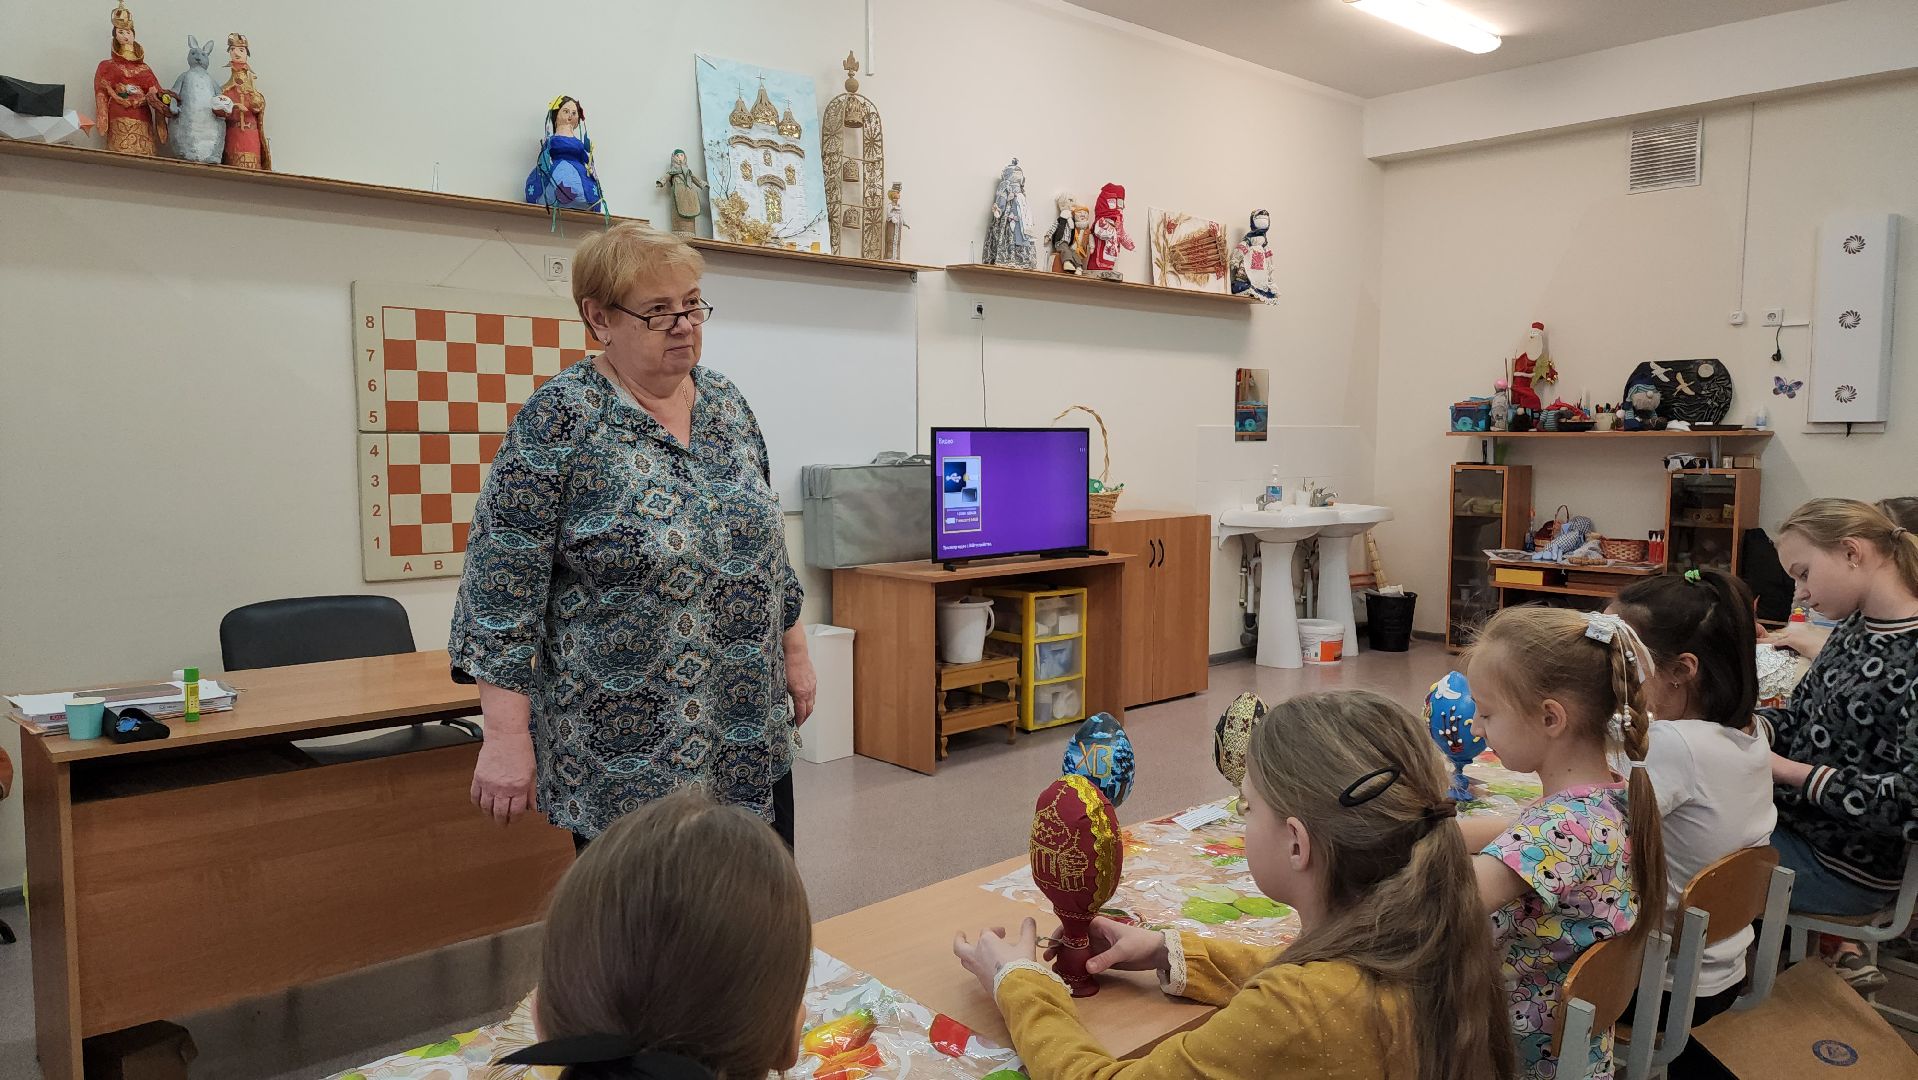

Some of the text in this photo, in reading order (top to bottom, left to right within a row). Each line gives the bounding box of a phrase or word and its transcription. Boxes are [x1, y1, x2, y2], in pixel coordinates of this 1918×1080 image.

[365, 315, 375, 329] 8
[365, 348, 376, 363] 7
[367, 378, 378, 393] 6
[368, 410, 378, 424] 5
[369, 444, 380, 458] 4
[370, 474, 380, 488] 3
[372, 503, 382, 517] 2
[373, 536, 380, 550] 1
[402, 559, 444, 573] A B
[1076, 741, 1111, 778] ХВ
